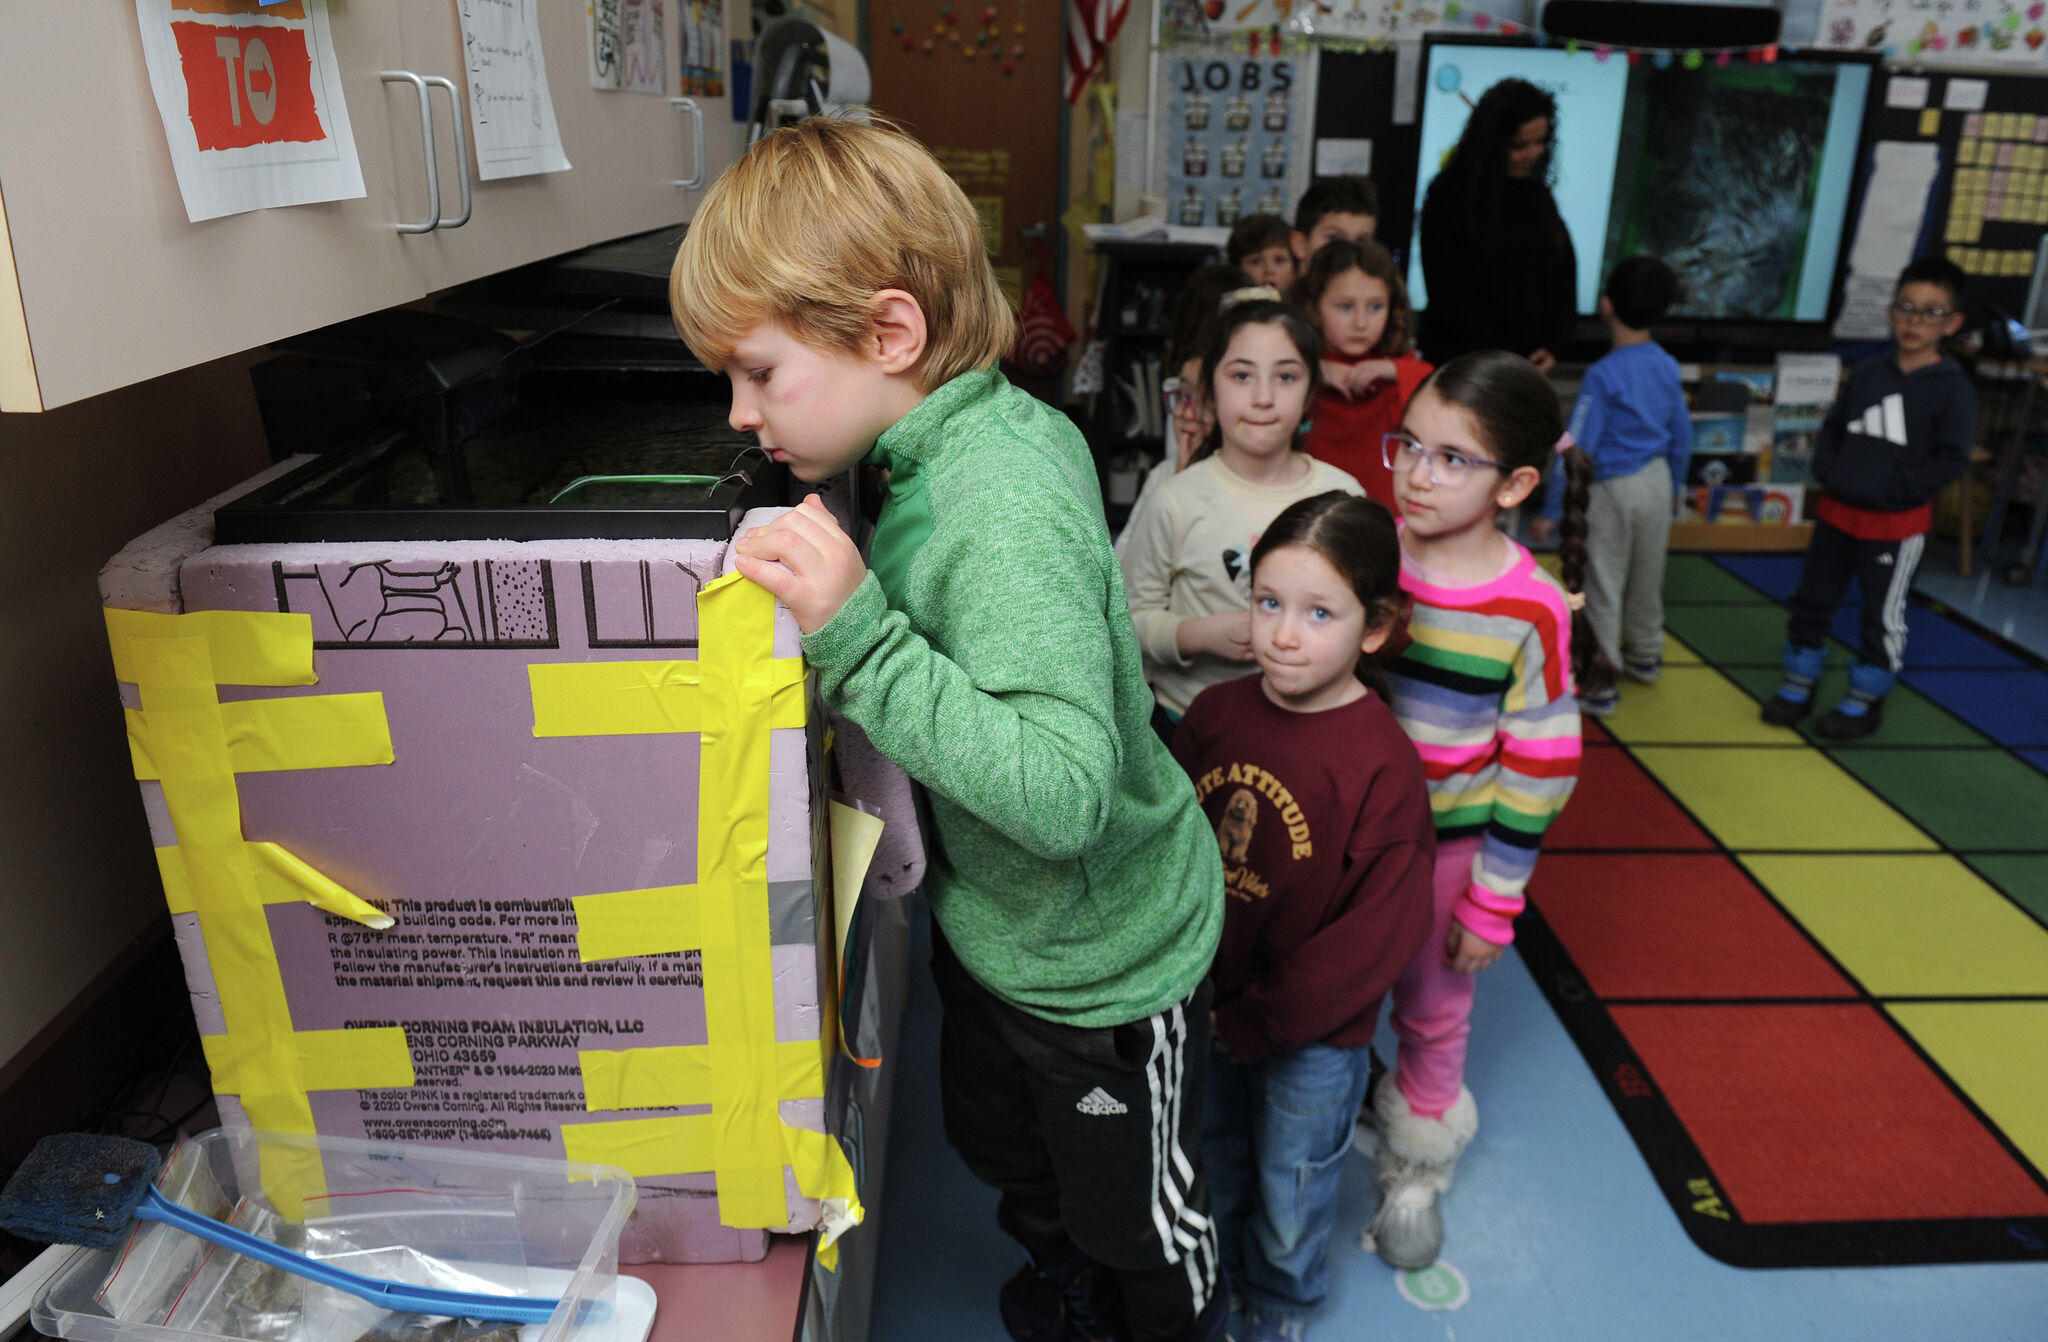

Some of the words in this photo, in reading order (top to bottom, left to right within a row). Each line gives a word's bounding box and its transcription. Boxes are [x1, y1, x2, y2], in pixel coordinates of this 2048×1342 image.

[1181, 60, 1292, 93] JOBS
[1227, 762, 1313, 861] ATTITUDE
[392, 898, 421, 912] This
[425, 898, 477, 912] product
[479, 898, 492, 912] is
[404, 914, 456, 928] building
[459, 914, 496, 926] code.
[499, 914, 521, 926] For
[524, 915, 559, 926] more
[328, 932, 338, 944] R
[387, 934, 425, 944] mean
[427, 932, 512, 946] temperature.
[539, 934, 577, 943] mean
[330, 947, 352, 959] the
[355, 947, 419, 961] insulating
[422, 948, 465, 961] power.
[468, 946, 497, 959] This
[500, 946, 564, 959] insulation
[333, 961, 376, 973] Follow
[380, 961, 401, 973] the
[505, 961, 583, 973] instructions
[586, 961, 645, 974] carefully.
[648, 960, 658, 972] If
[661, 962, 669, 972] a
[672, 962, 702, 972] man
[335, 975, 358, 987] the
[360, 975, 414, 987] material
[483, 976, 533, 989] request
[535, 974, 561, 987] this
[563, 974, 588, 987] and
[591, 974, 634, 986] review
[637, 974, 646, 986] it
[401, 1020, 469, 1034] CORNING
[471, 1020, 516, 1034] FOAM
[519, 1020, 613, 1036] INSULATION,
[616, 1020, 644, 1034] LLC
[438, 1035, 505, 1048] CORNING
[507, 1035, 580, 1048] PARKWAY
[413, 1050, 450, 1062] OHIO
[453, 1050, 497, 1063] 43659
[474, 1065, 482, 1076] &
[497, 1065, 556, 1076] 1964-2020
[414, 1077, 462, 1087] eserved.
[357, 1089, 378, 1100] The
[381, 1089, 408, 1100] color
[410, 1090, 438, 1100] PINK
[440, 1089, 450, 1100] is
[453, 1092, 460, 1100] a
[462, 1089, 517, 1102] registered
[519, 1089, 576, 1100] trademark
[373, 1101, 401, 1111] 2020
[403, 1101, 440, 1111] Owens
[442, 1101, 488, 1113] Corning.
[490, 1101, 504, 1111] All
[507, 1100, 542, 1113] Rights
[544, 1101, 587, 1111] Reserve
[362, 1117, 507, 1130] www.owenscorning.com
